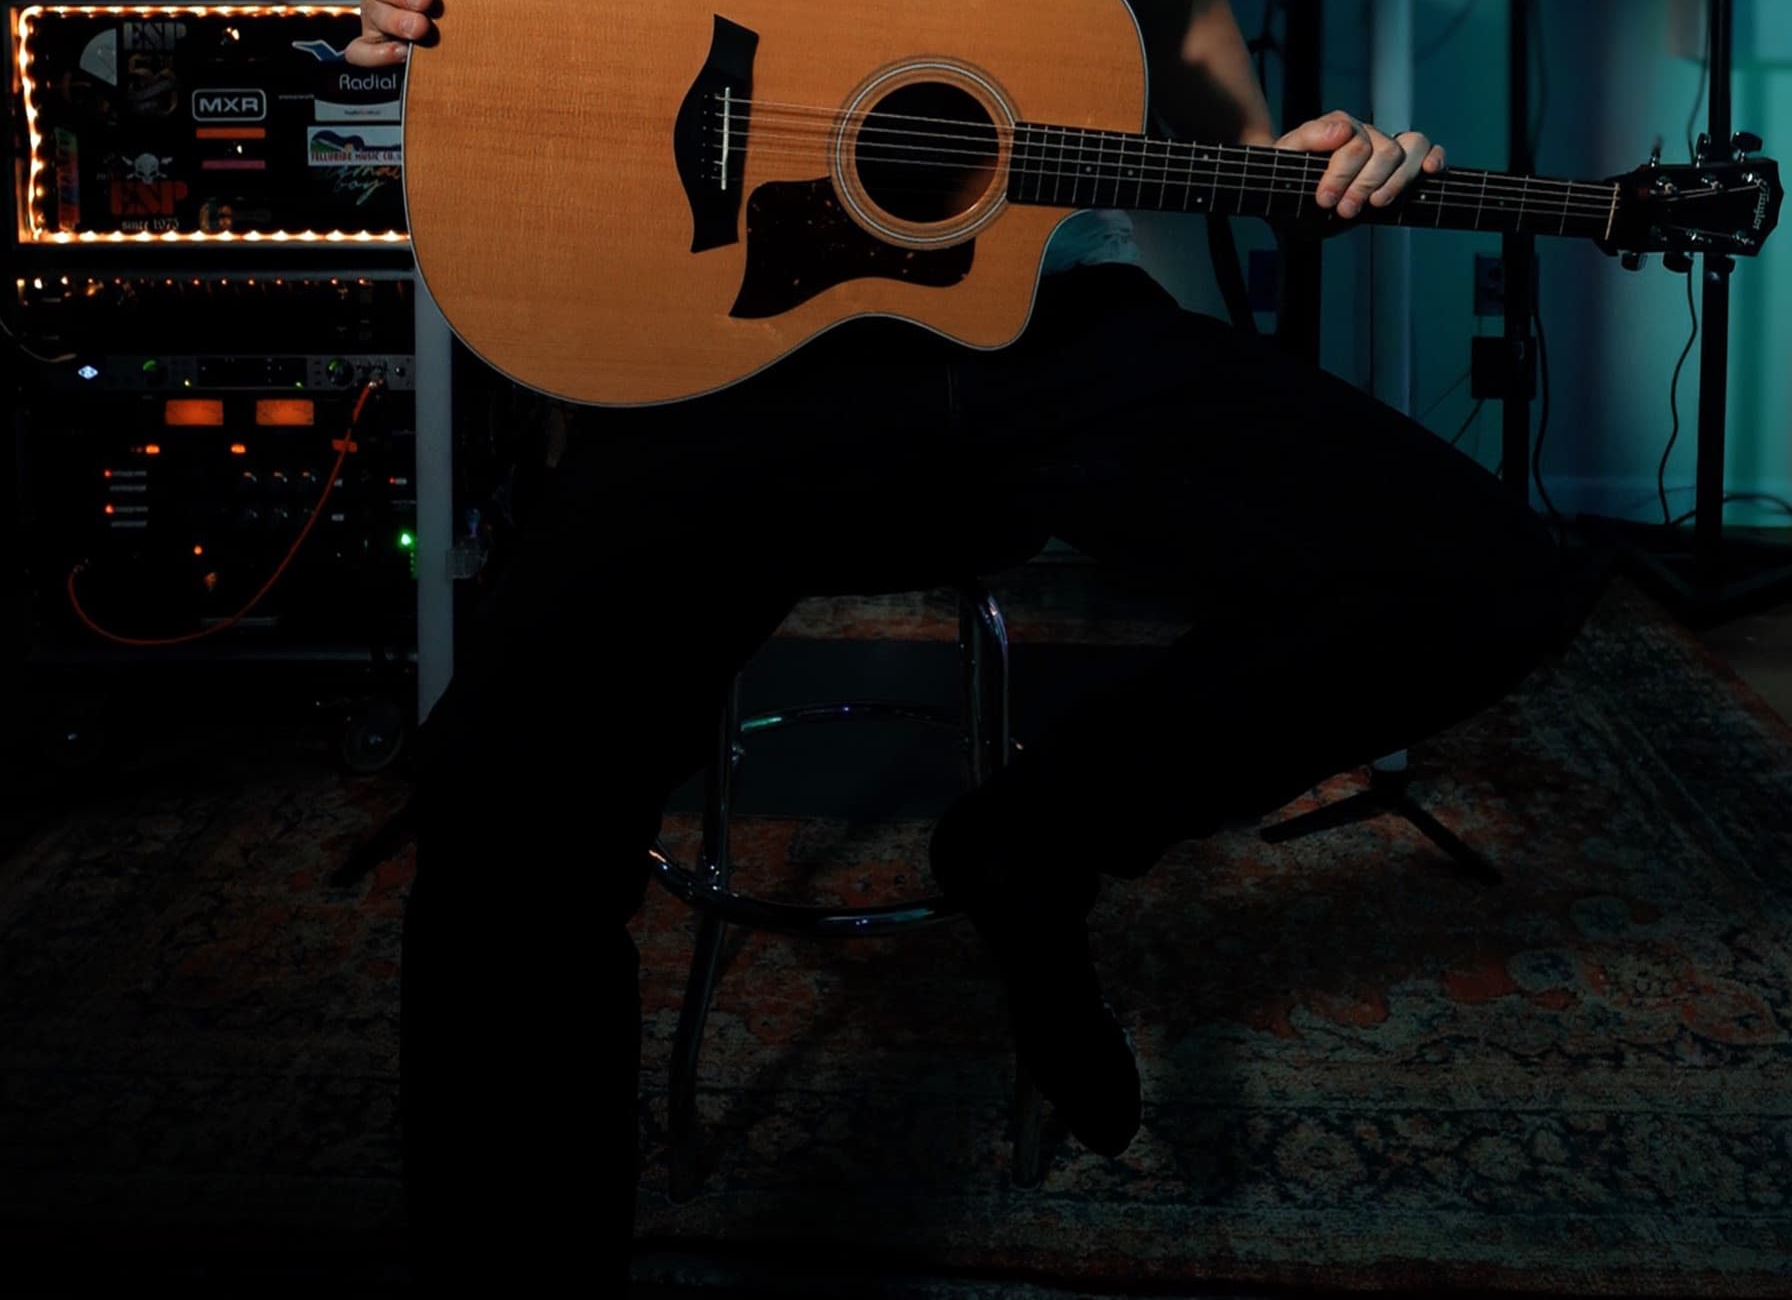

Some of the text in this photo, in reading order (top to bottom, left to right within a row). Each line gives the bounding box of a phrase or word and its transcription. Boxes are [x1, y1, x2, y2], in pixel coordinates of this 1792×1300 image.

[123, 22, 187, 51] ESP
[339, 73, 397, 91] Radial
[199, 97, 259, 113] MXR
[110, 180, 189, 216] ESP
